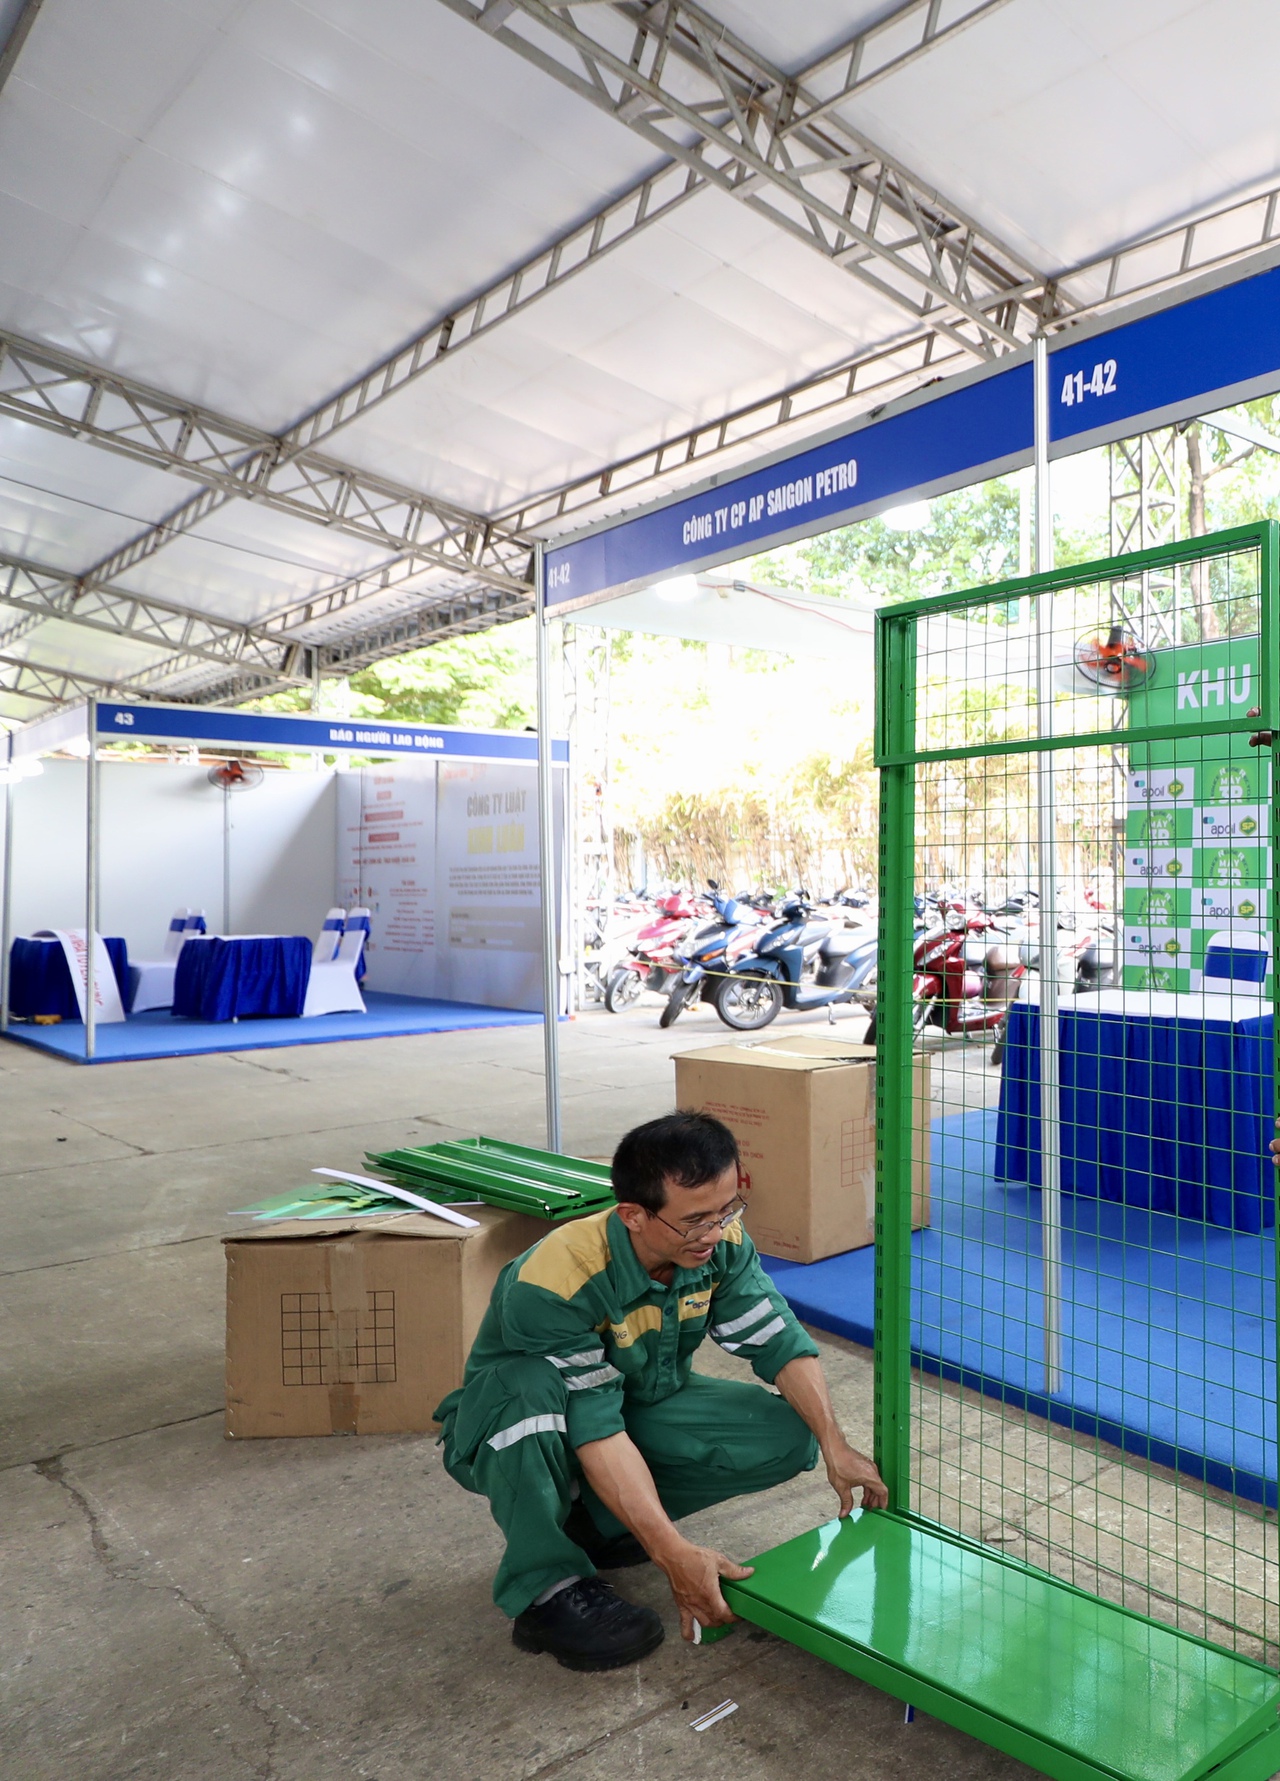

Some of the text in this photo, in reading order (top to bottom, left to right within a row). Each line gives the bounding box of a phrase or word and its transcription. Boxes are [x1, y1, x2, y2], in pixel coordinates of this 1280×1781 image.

[1061, 359, 1117, 407] 41-42
[683, 459, 857, 545] CÔNG TY CP AP SAIGON PETRO
[548, 562, 570, 588] 41-42
[1177, 663, 1251, 710] KHU
[114, 711, 135, 726] 43
[329, 728, 354, 742] BÁO
[467, 791, 490, 817] CÔNG
[492, 793, 504, 815] TY
[1219, 786, 1243, 804] 3R
[1211, 822, 1254, 837] apol SP
[1217, 868, 1241, 886] 3R
[1210, 906, 1234, 920] apol
